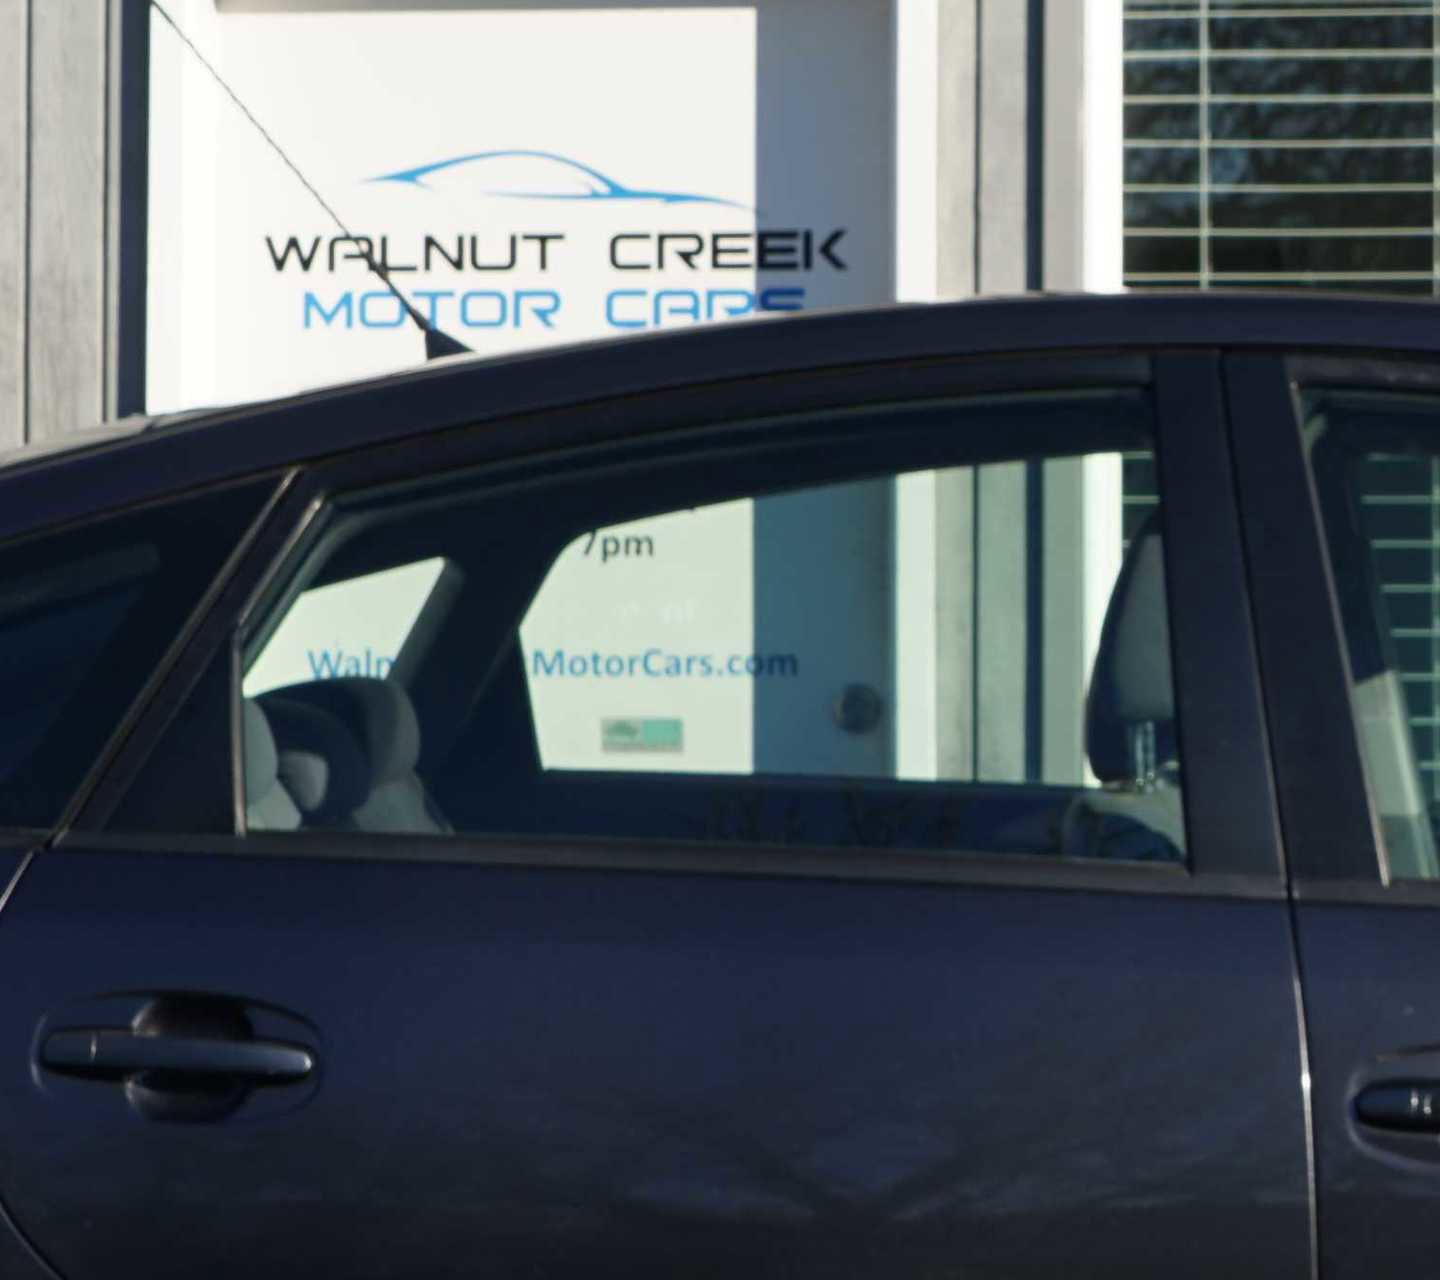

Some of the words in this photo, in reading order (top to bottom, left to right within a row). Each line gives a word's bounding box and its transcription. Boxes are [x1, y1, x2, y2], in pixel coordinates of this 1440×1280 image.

[265, 234, 565, 272] WALNUT
[609, 229, 848, 270] CREEK
[303, 289, 561, 330] MOTOR
